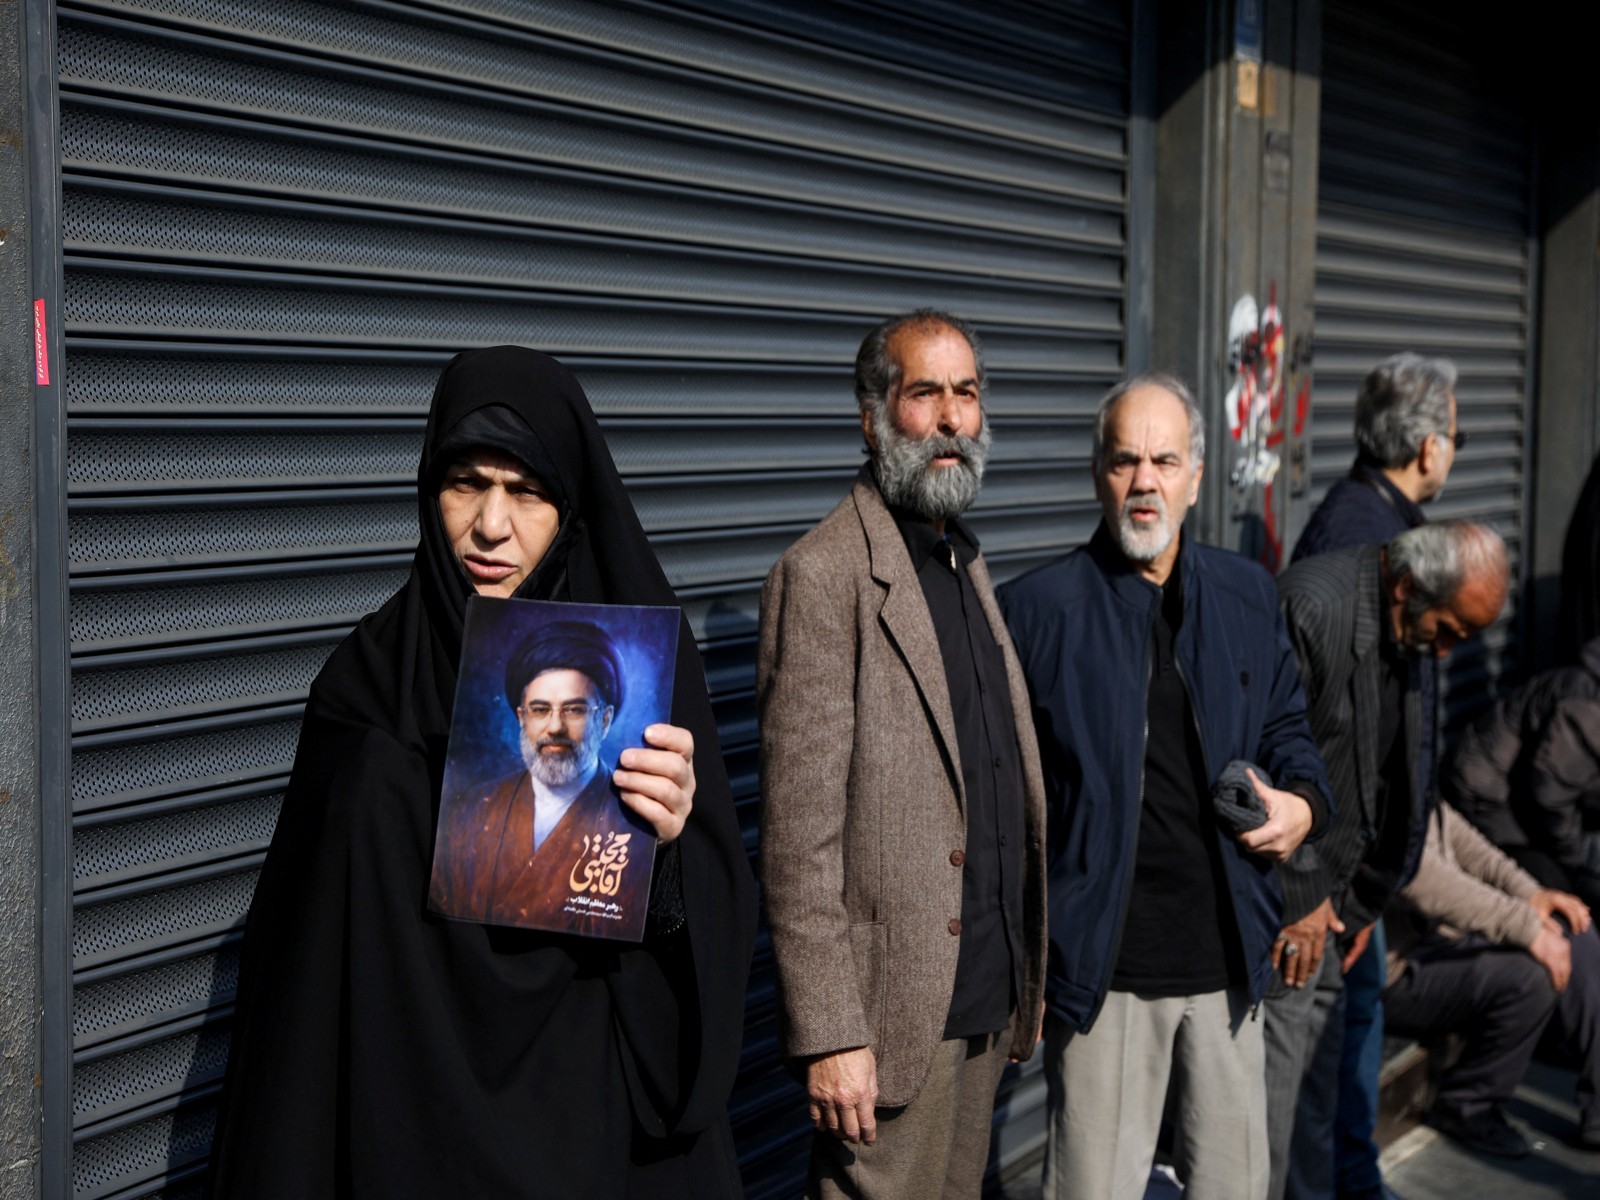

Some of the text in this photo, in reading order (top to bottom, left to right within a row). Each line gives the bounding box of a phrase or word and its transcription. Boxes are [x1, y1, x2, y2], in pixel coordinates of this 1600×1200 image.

[599, 845, 630, 896] آقا
[570, 895, 590, 905] انقلاب
[589, 898, 606, 909] معظم
[605, 902, 619, 913] رهبر
